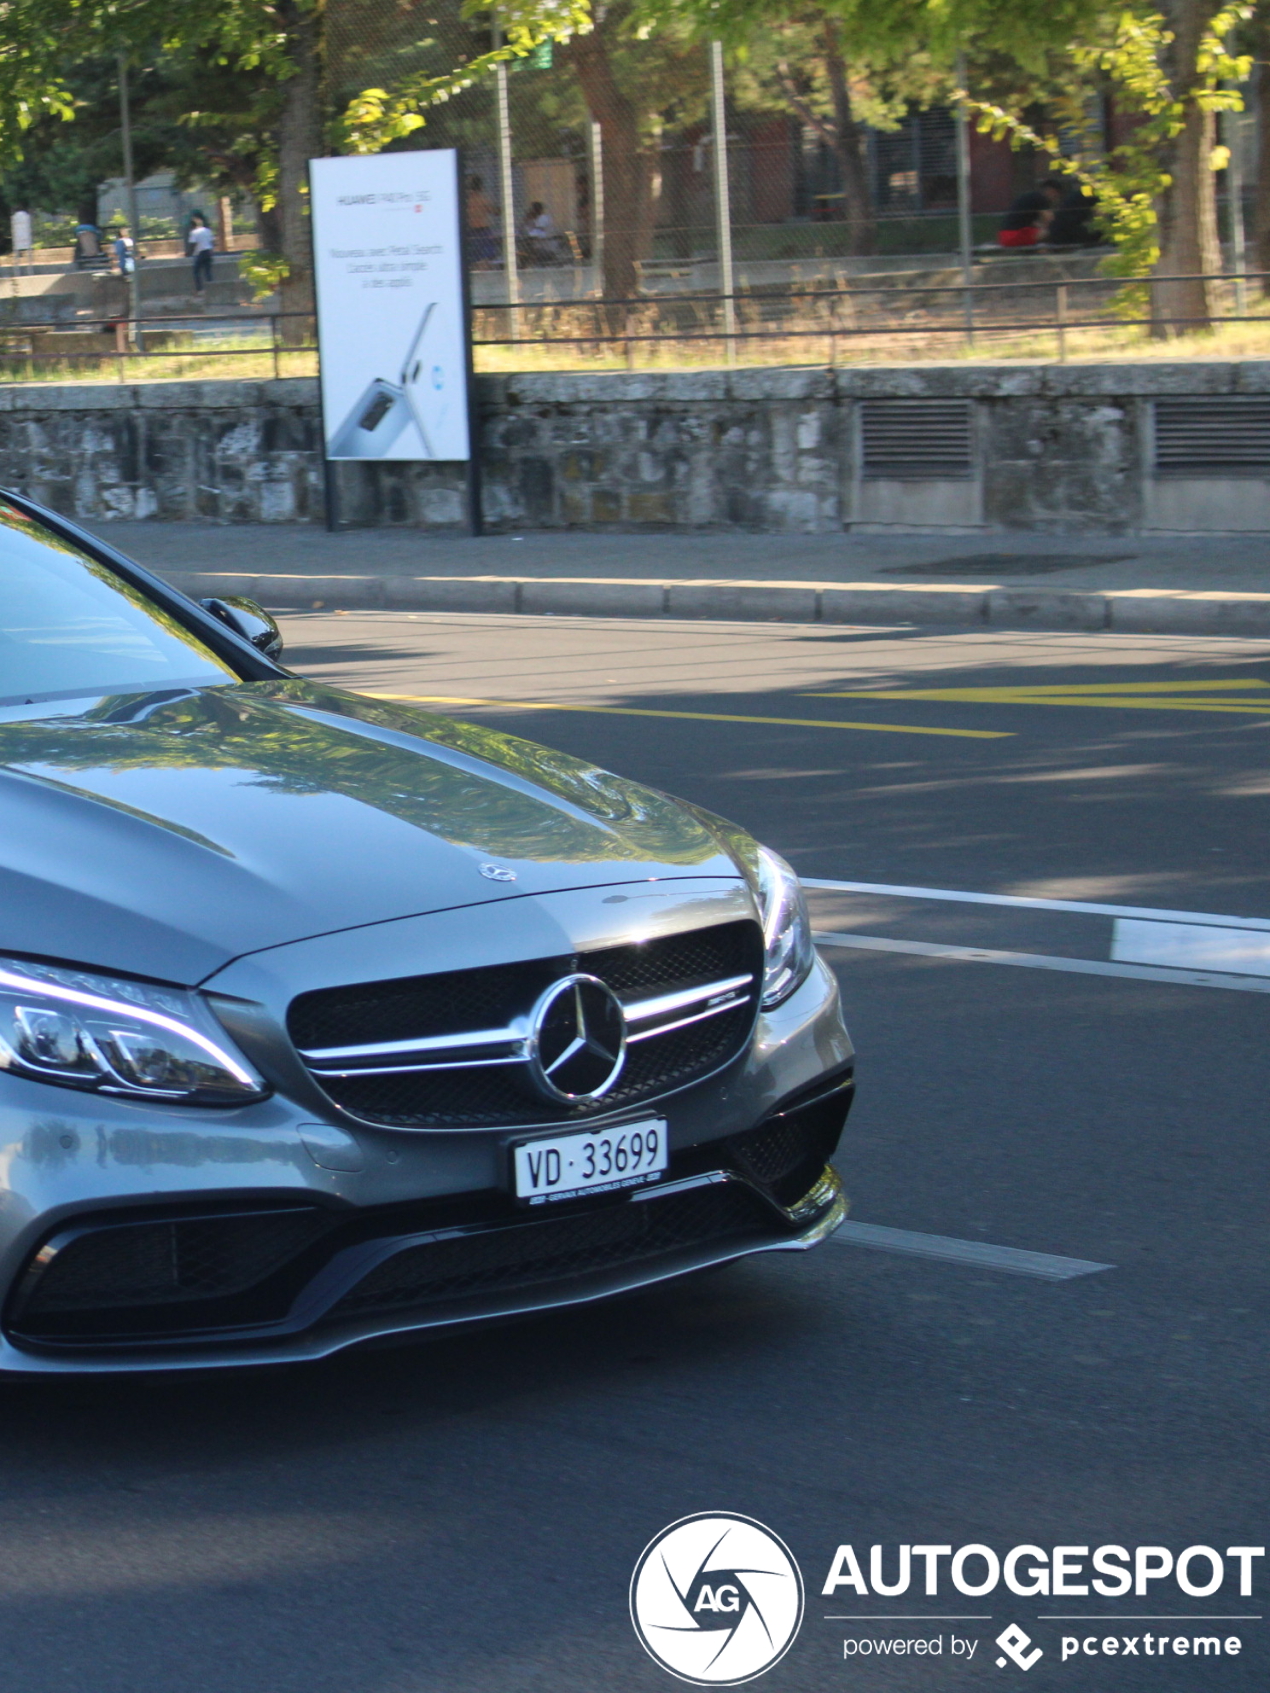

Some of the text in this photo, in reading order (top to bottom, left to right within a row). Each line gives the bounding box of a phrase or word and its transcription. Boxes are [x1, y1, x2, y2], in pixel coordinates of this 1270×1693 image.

[336, 193, 377, 206] HUAWEI
[527, 1149, 560, 1188] VD
[582, 1129, 658, 1178] 33699
